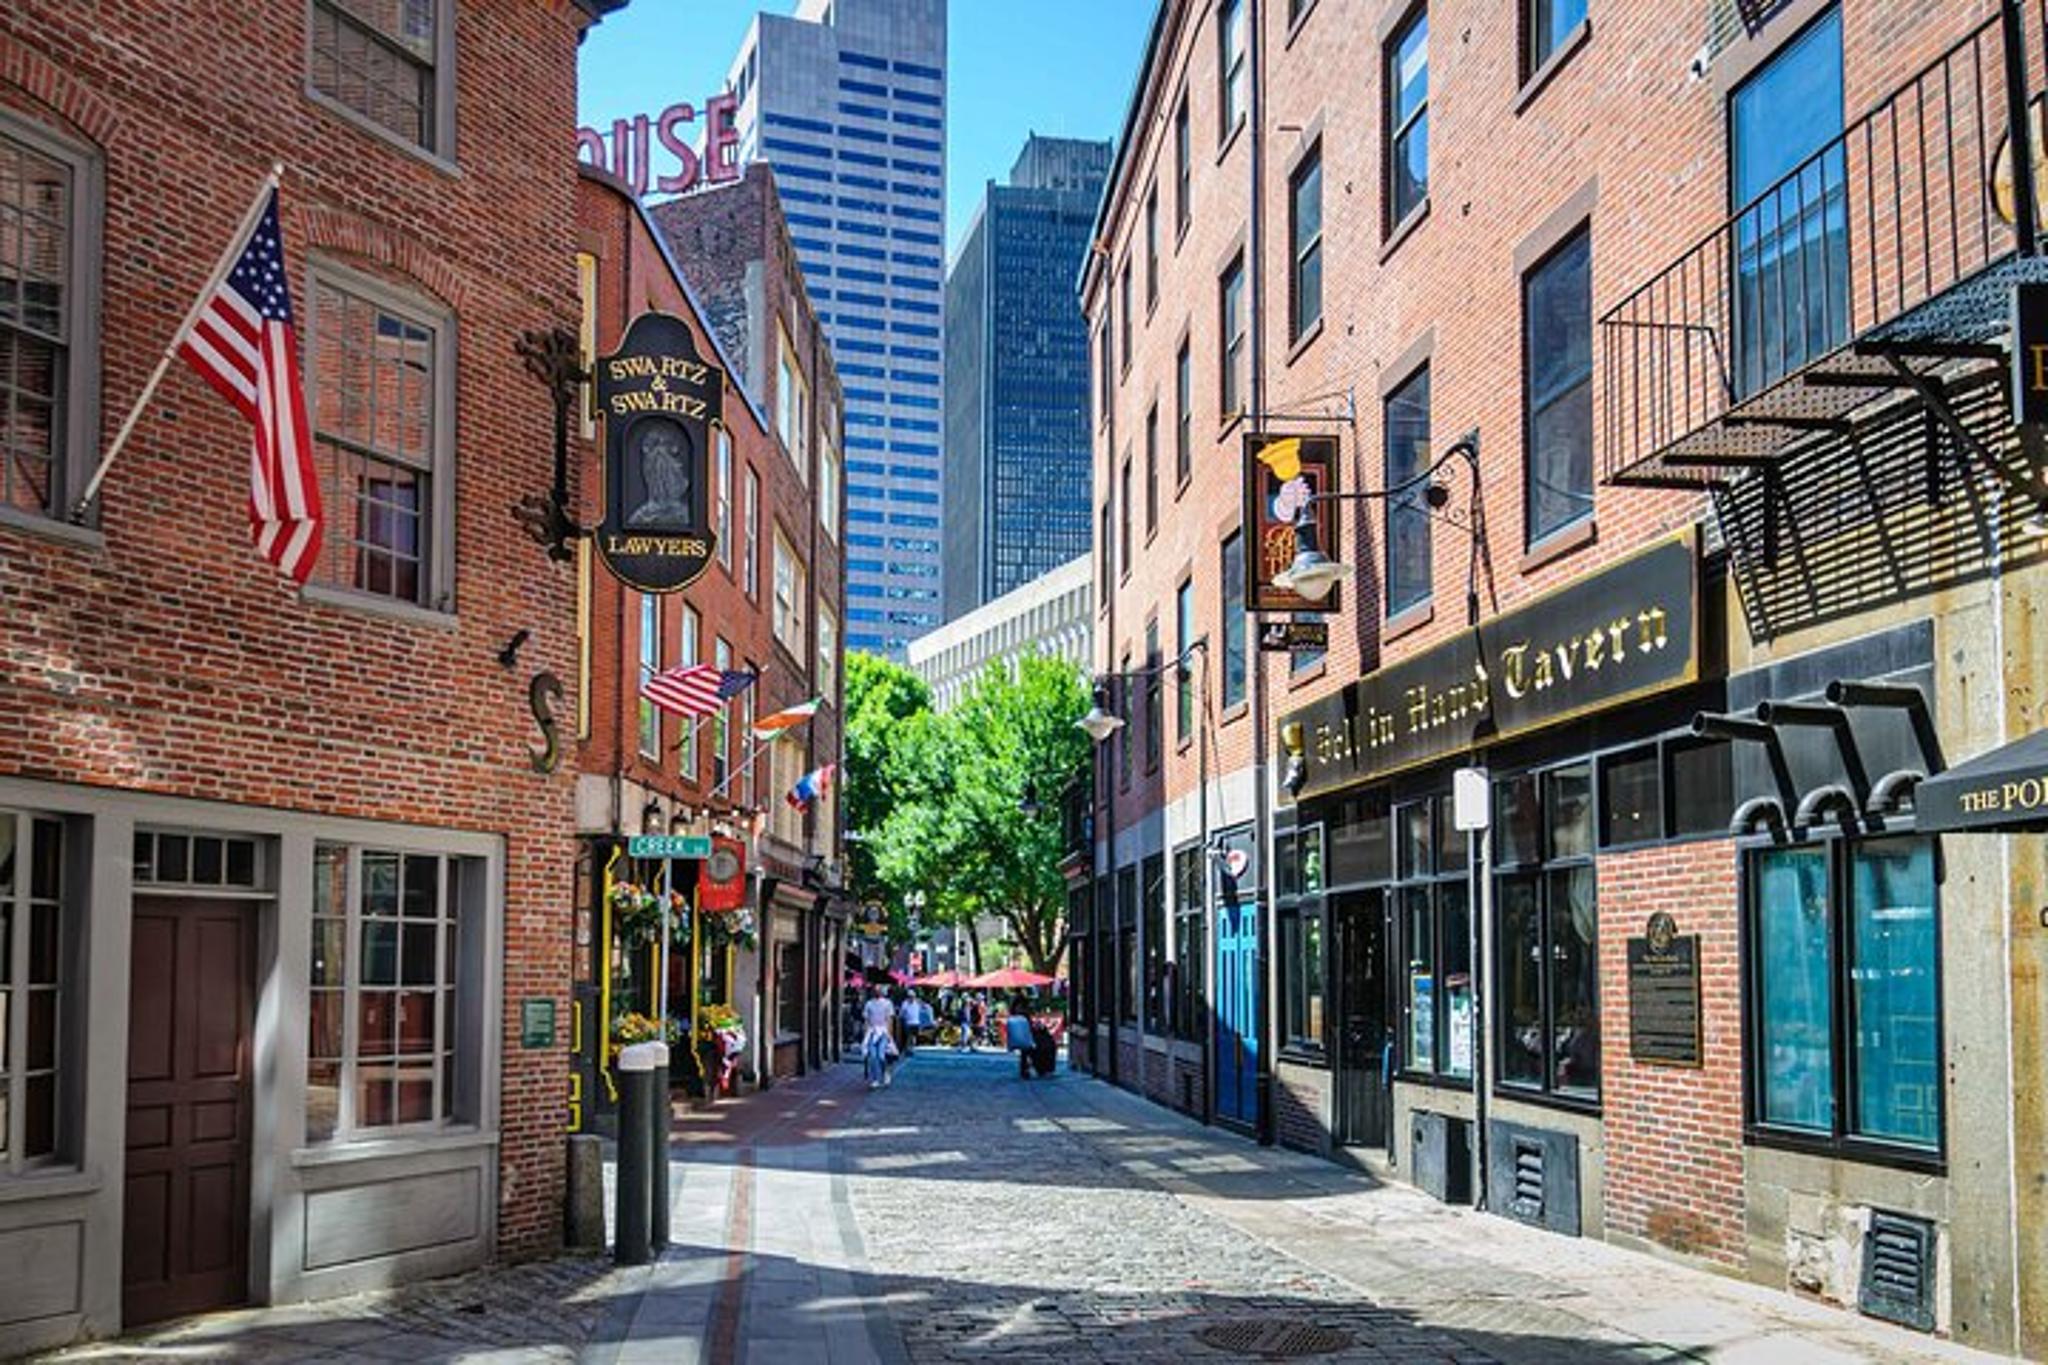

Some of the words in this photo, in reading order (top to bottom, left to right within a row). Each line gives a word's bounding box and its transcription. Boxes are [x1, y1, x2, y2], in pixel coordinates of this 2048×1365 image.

[608, 355, 708, 385] SWARTZ
[651, 374, 668, 391] &
[610, 391, 708, 420] SWARTZ
[607, 534, 707, 558] LAWYERS
[1369, 697, 1395, 748] in
[1406, 660, 1490, 734] Hand
[1501, 606, 1668, 698] Tavern
[1960, 788, 2000, 813] THE
[636, 838, 682, 854] CREEK
